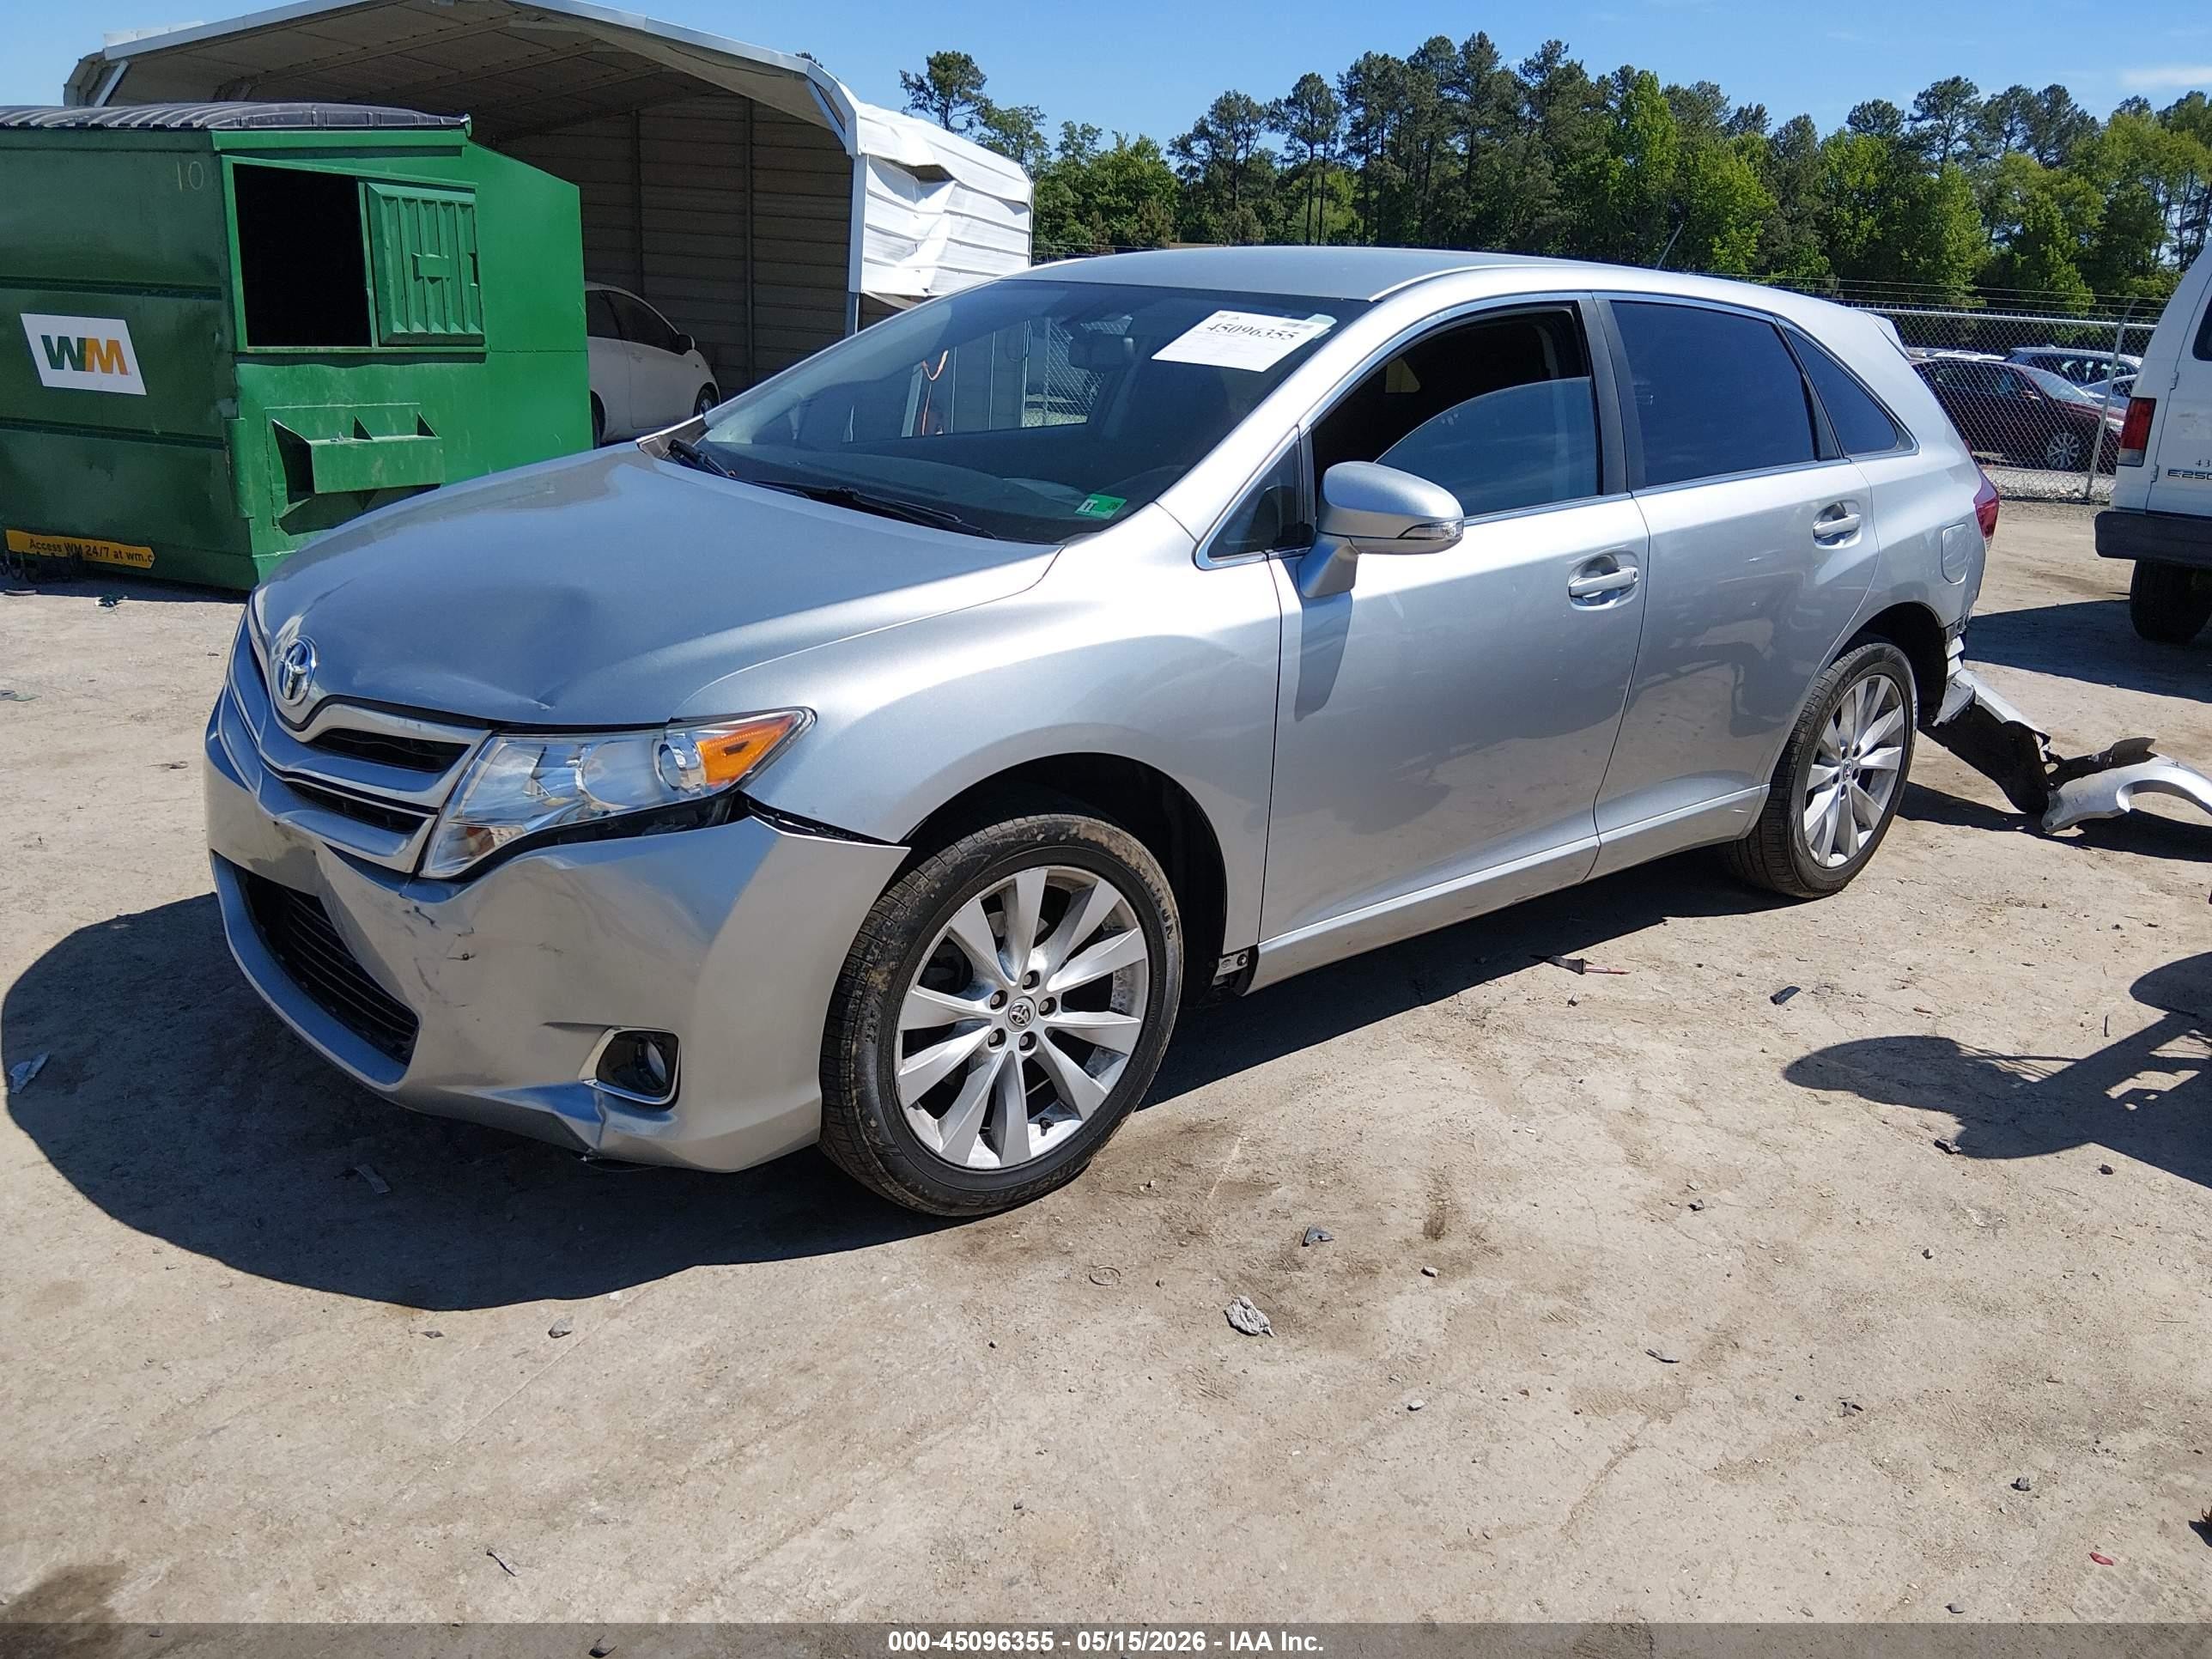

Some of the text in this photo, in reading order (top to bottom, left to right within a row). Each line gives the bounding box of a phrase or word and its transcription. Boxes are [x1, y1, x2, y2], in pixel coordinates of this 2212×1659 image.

[177, 161, 204, 192] 10
[1206, 322, 1299, 341] 45096355
[40, 334, 128, 375] WM
[29, 538, 63, 553] Access
[86, 545, 110, 558] 24/7
[113, 550, 124, 560] at
